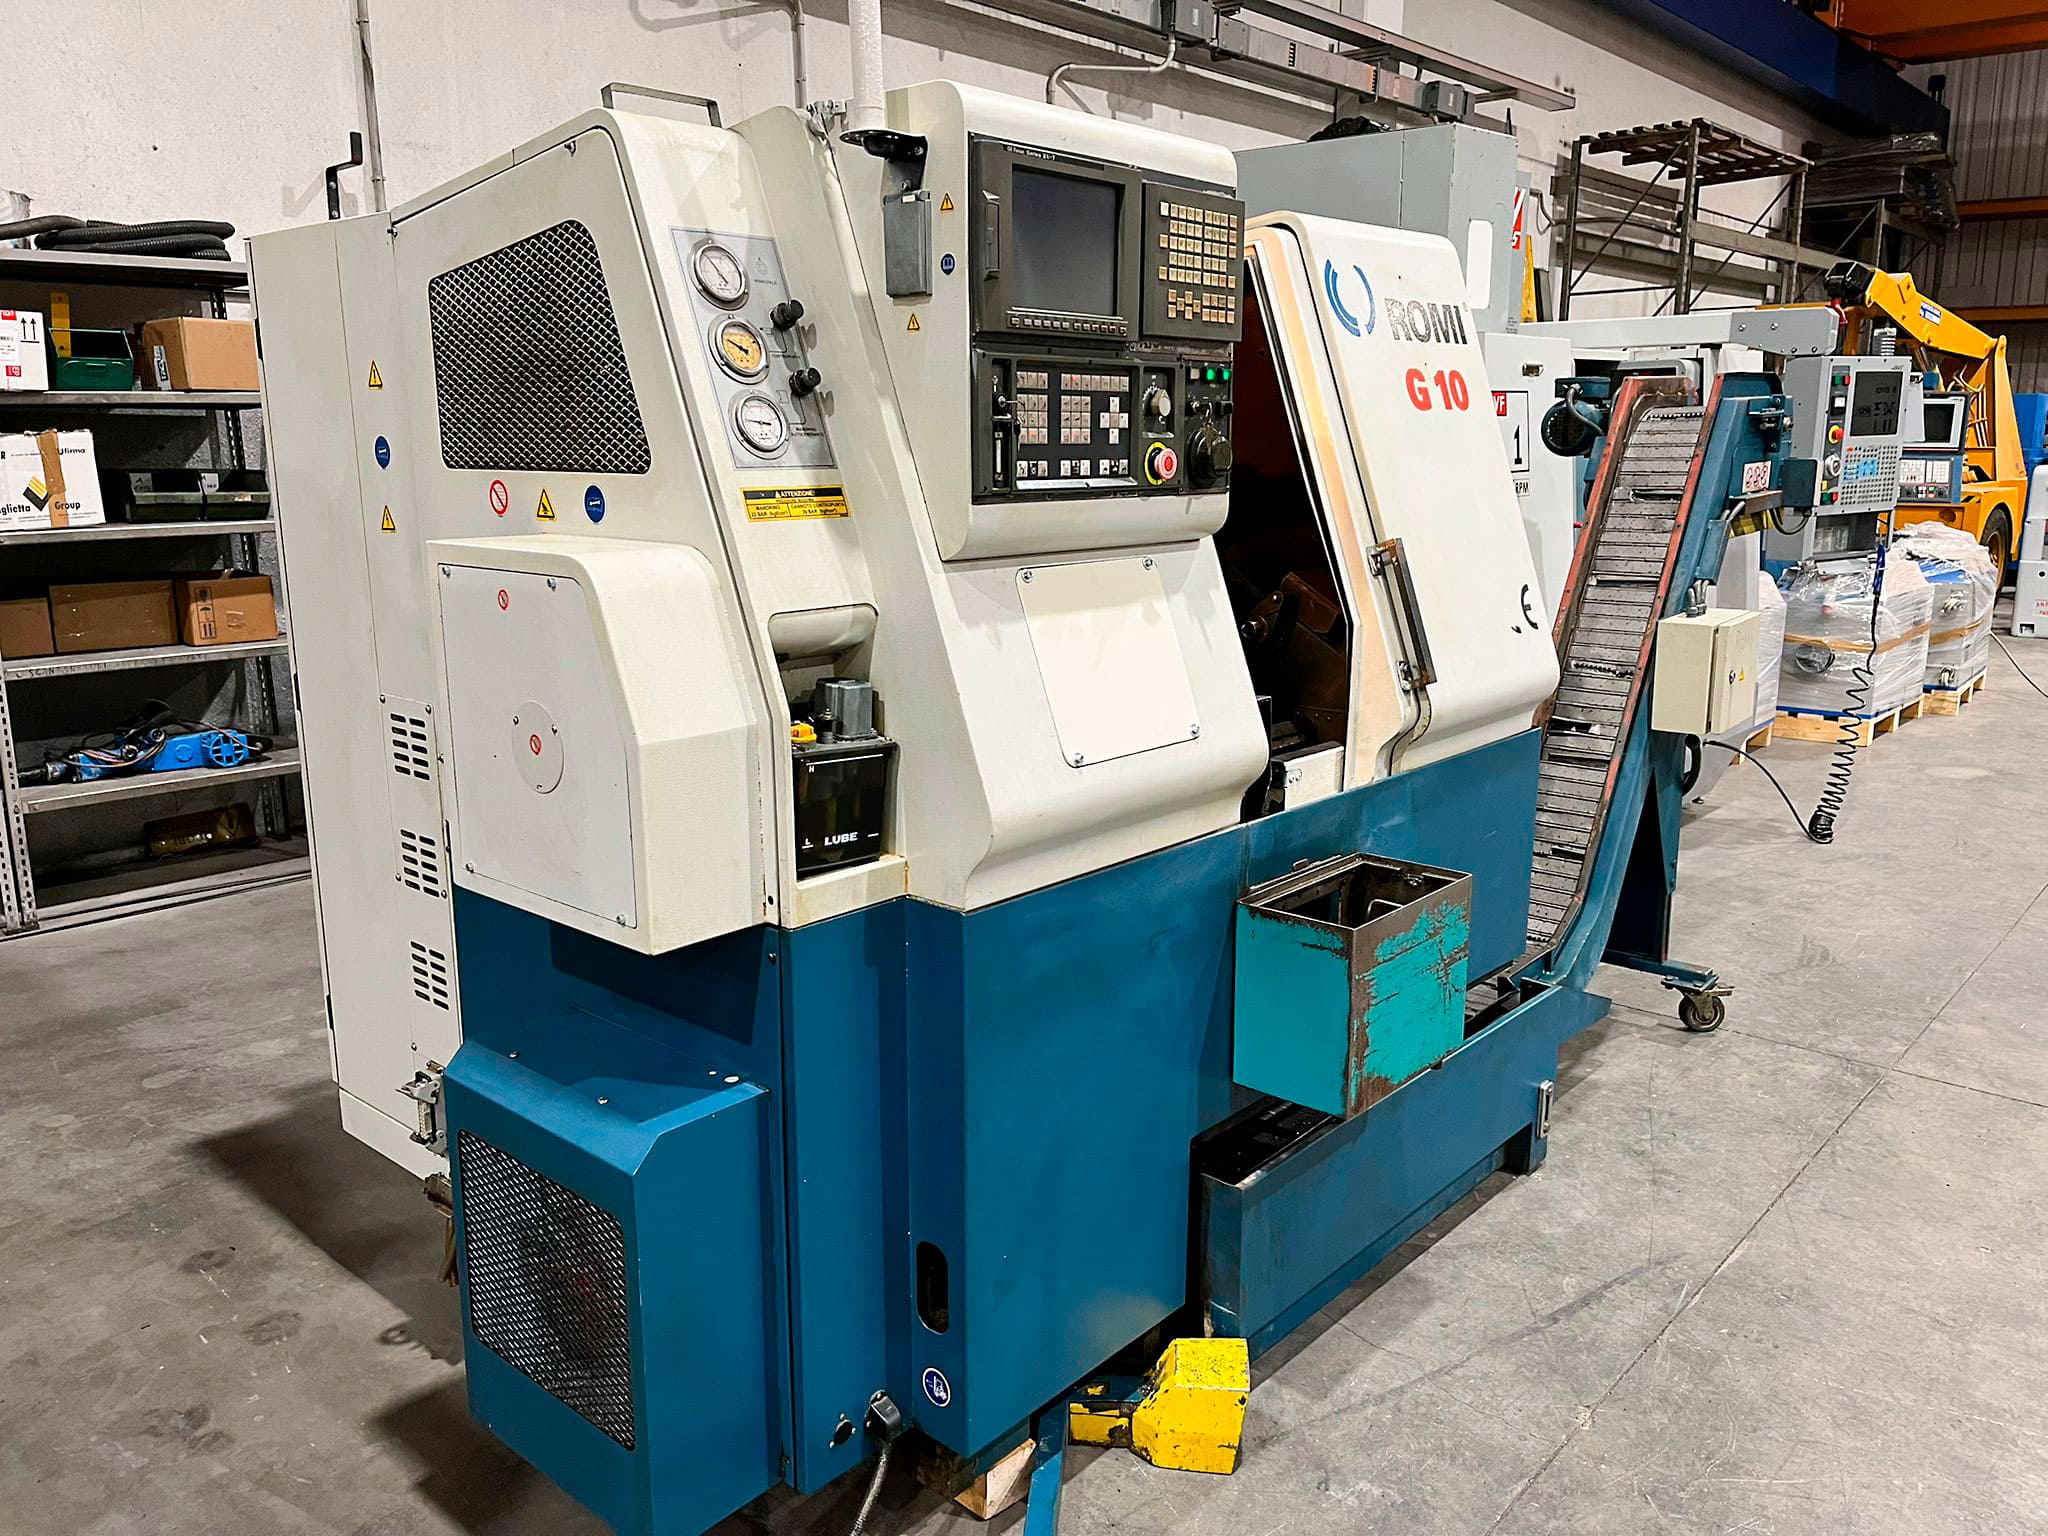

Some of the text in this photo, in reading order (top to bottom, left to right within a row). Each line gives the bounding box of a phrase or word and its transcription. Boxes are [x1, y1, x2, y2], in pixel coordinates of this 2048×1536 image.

[1384, 298, 1468, 345] ROMI
[0, 501, 81, 516] glietta Group
[824, 832, 858, 846] LUBE
